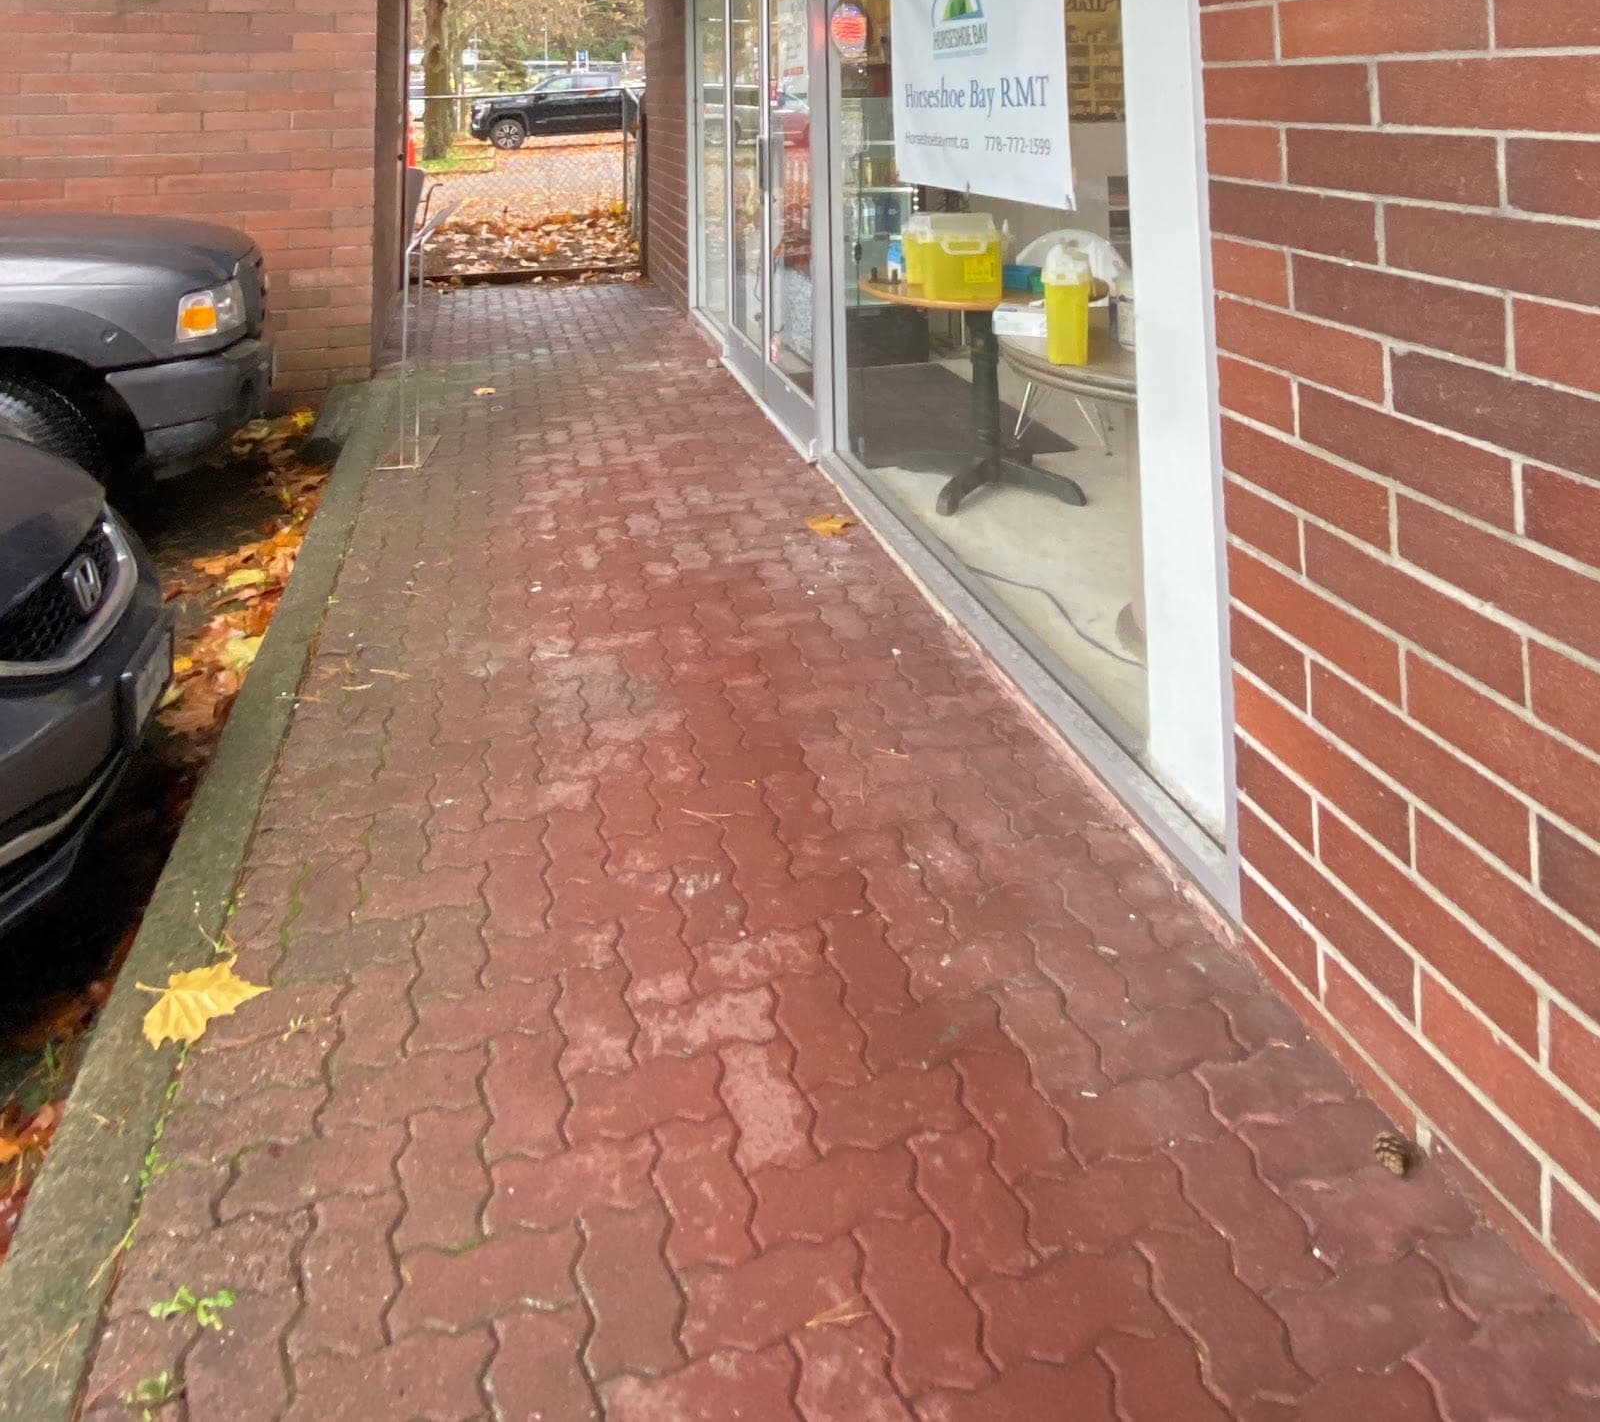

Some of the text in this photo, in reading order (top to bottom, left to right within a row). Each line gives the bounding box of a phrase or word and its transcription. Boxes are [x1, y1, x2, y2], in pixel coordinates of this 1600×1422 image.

[933, 22, 988, 50] HORSESHOE BAY
[905, 75, 1049, 119] Horseshoe Bay RMT
[983, 135, 1051, 156] 778-772-1599
